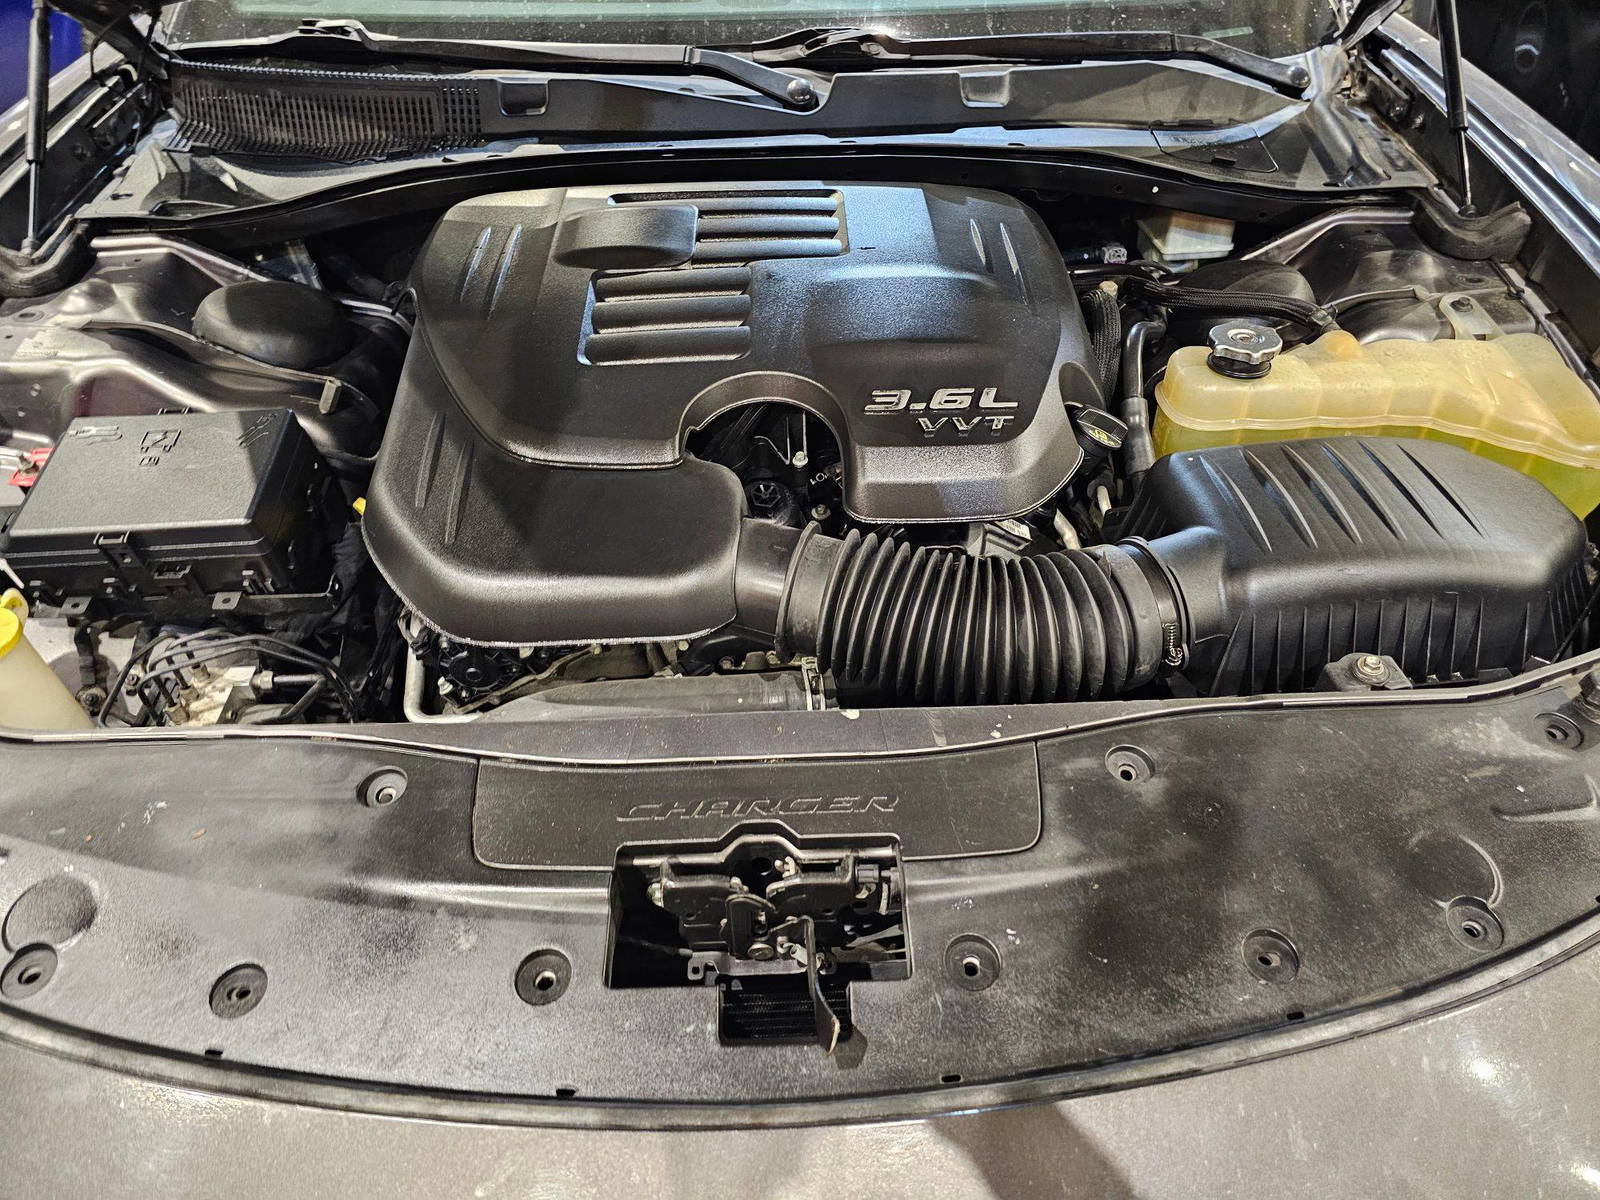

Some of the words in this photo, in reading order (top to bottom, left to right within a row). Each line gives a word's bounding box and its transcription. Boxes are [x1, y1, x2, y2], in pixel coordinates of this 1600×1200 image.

[864, 387, 1019, 412] 3.6L
[917, 415, 1015, 432] VVT
[616, 796, 900, 822] CHARGER
